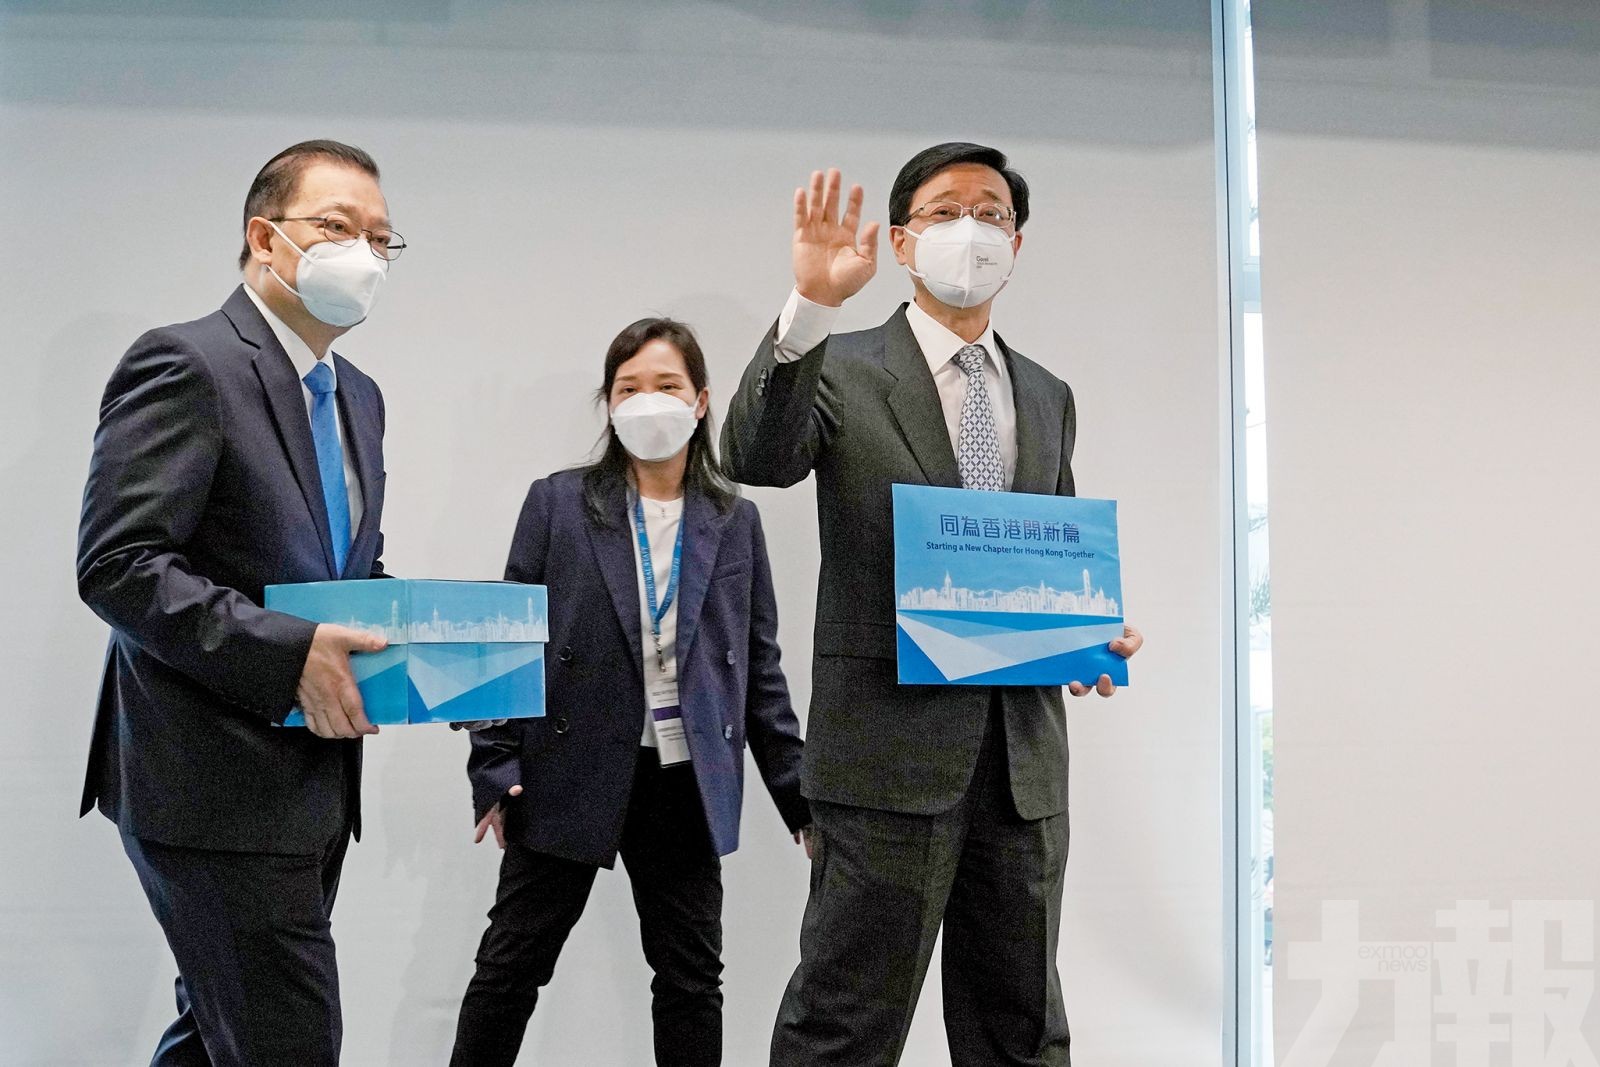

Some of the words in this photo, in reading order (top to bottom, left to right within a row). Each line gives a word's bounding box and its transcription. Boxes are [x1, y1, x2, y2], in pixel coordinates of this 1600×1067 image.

[940, 514, 1080, 543] 同為香港開新篇
[926, 541, 957, 552] Starting
[965, 543, 980, 551] New
[982, 544, 1011, 555] Chapter
[1013, 546, 1024, 554] for
[1025, 547, 1044, 557] Hong
[1045, 549, 1063, 559] Kong
[1064, 550, 1094, 560] Together
